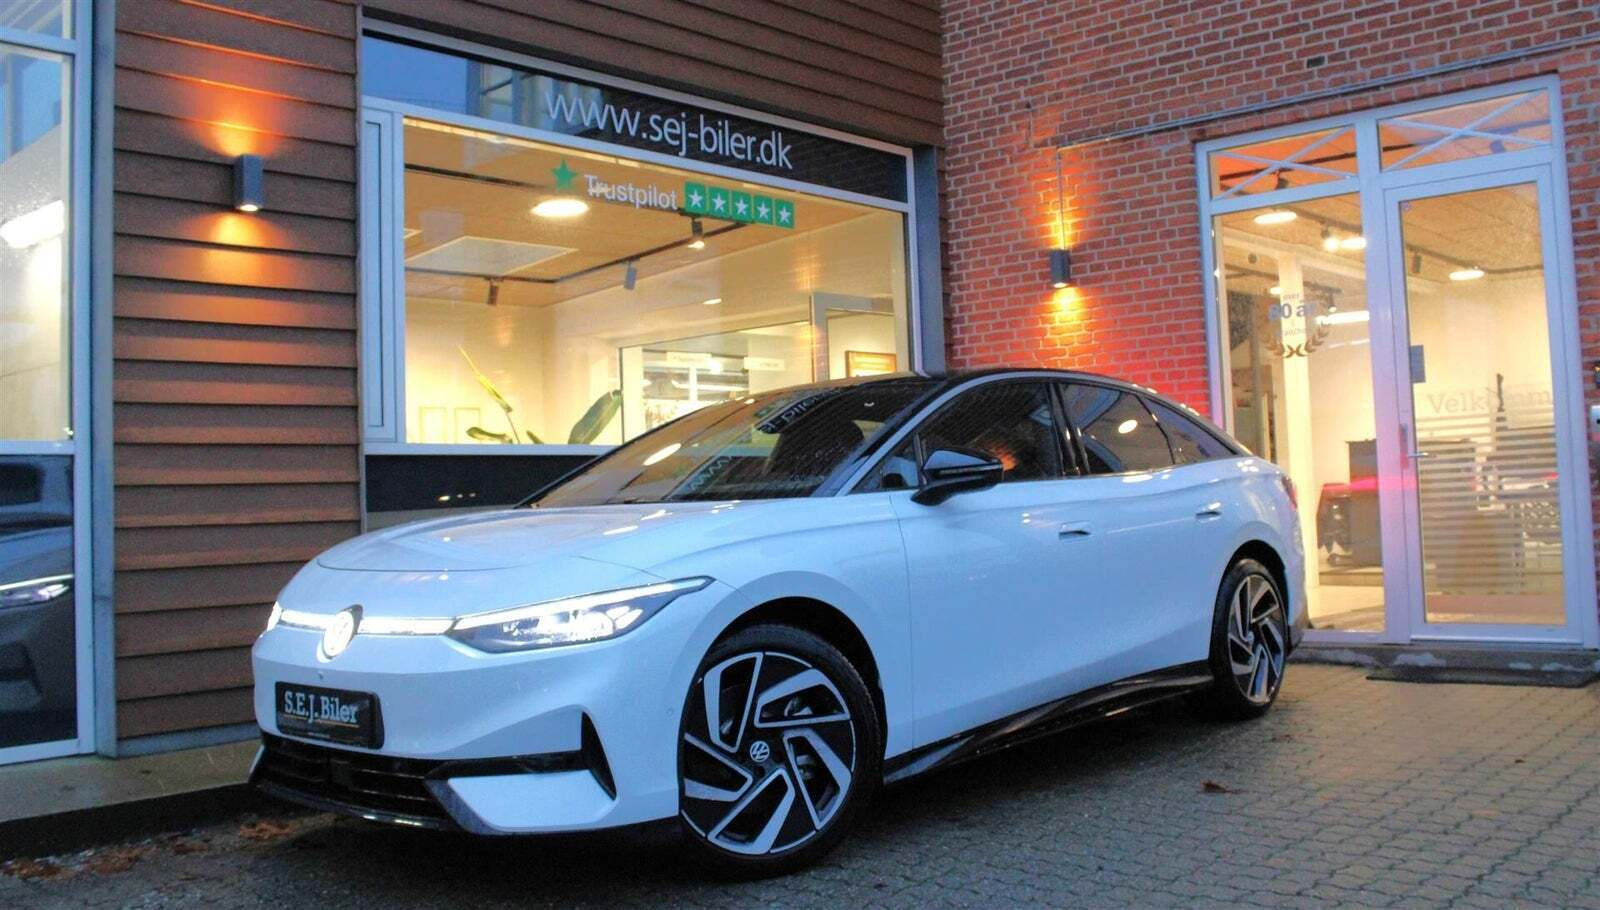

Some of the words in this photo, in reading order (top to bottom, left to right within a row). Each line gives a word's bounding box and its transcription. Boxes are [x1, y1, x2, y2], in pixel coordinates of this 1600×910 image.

[547, 93, 792, 169] www.sej-biler.dk
[584, 173, 679, 211] Trustpilot
[284, 690, 319, 723] S.E.J.
[320, 696, 359, 722] Biler
